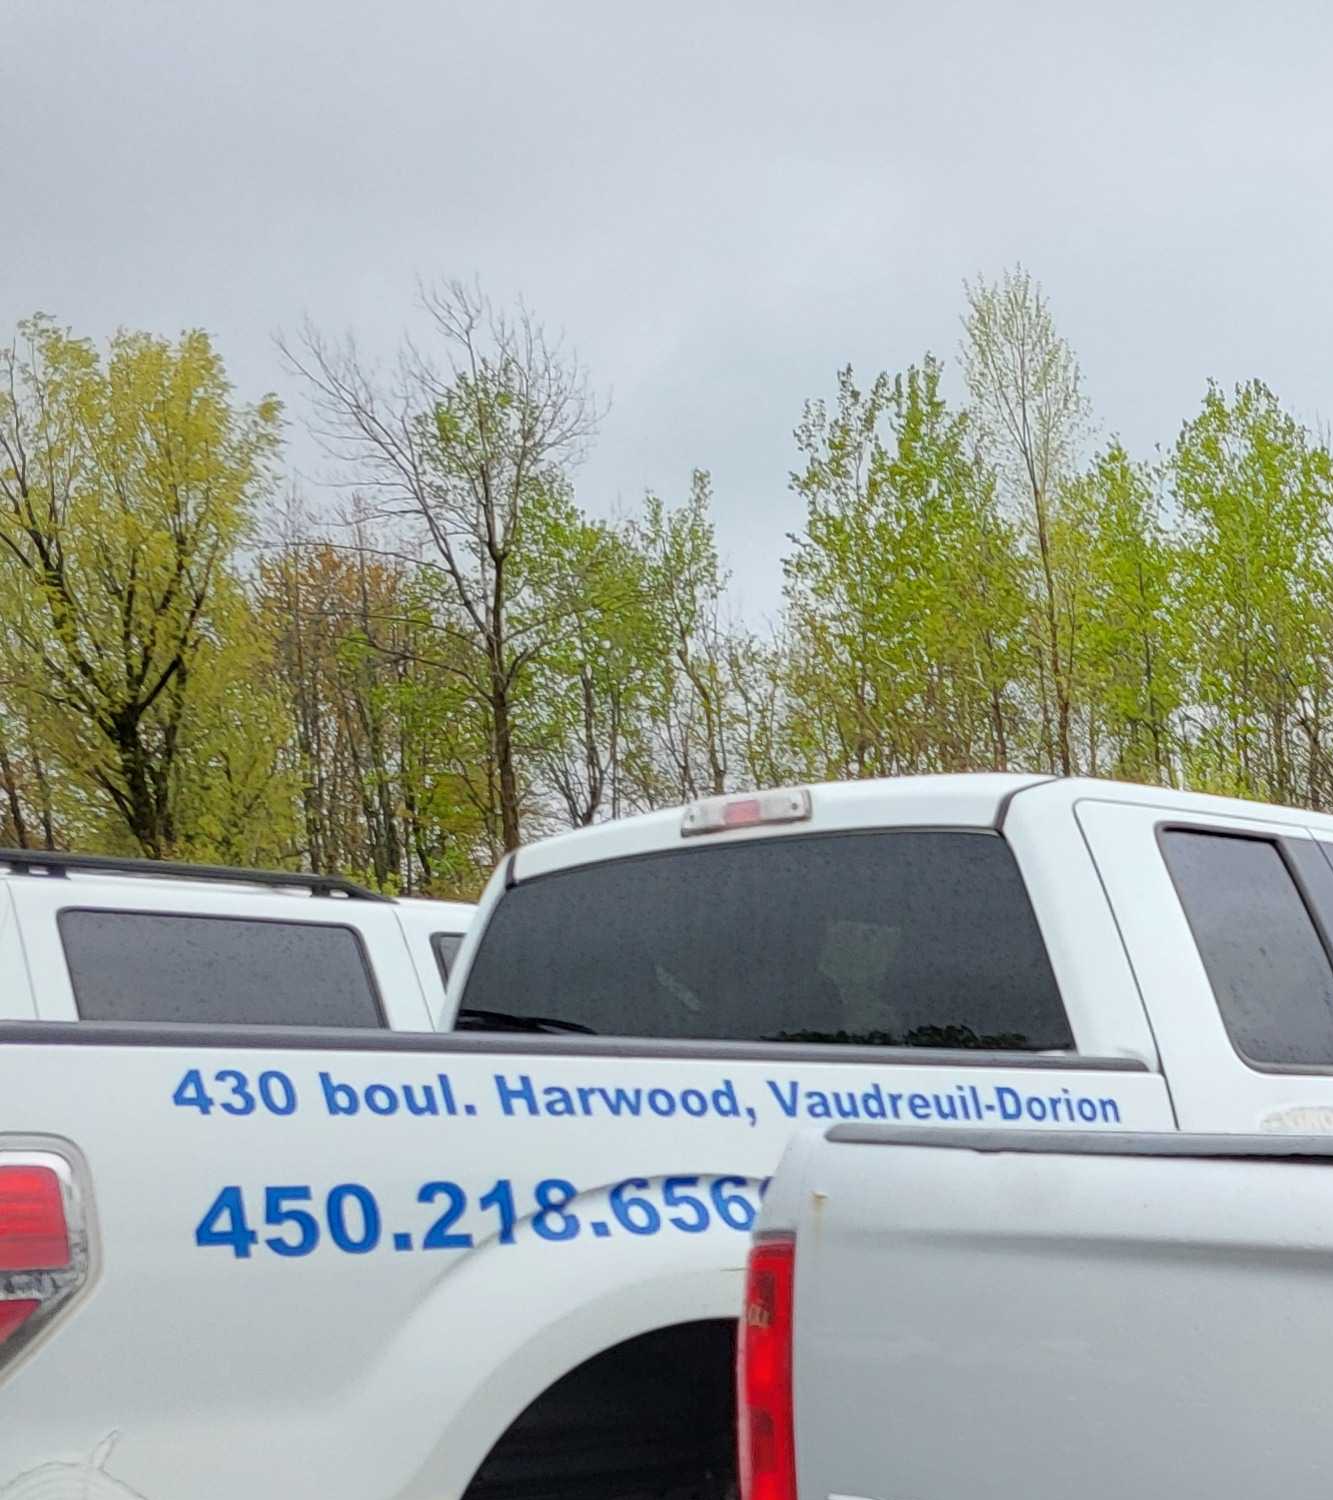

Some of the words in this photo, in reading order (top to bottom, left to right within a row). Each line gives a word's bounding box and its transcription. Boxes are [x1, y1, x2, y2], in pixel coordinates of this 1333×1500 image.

[172, 1068, 298, 1116] 430
[318, 1072, 477, 1117] boul.
[495, 1075, 757, 1127] Harwood,
[766, 1079, 1121, 1123] Vaudreuil-Dorion
[194, 1173, 773, 1258] 450.218.656
